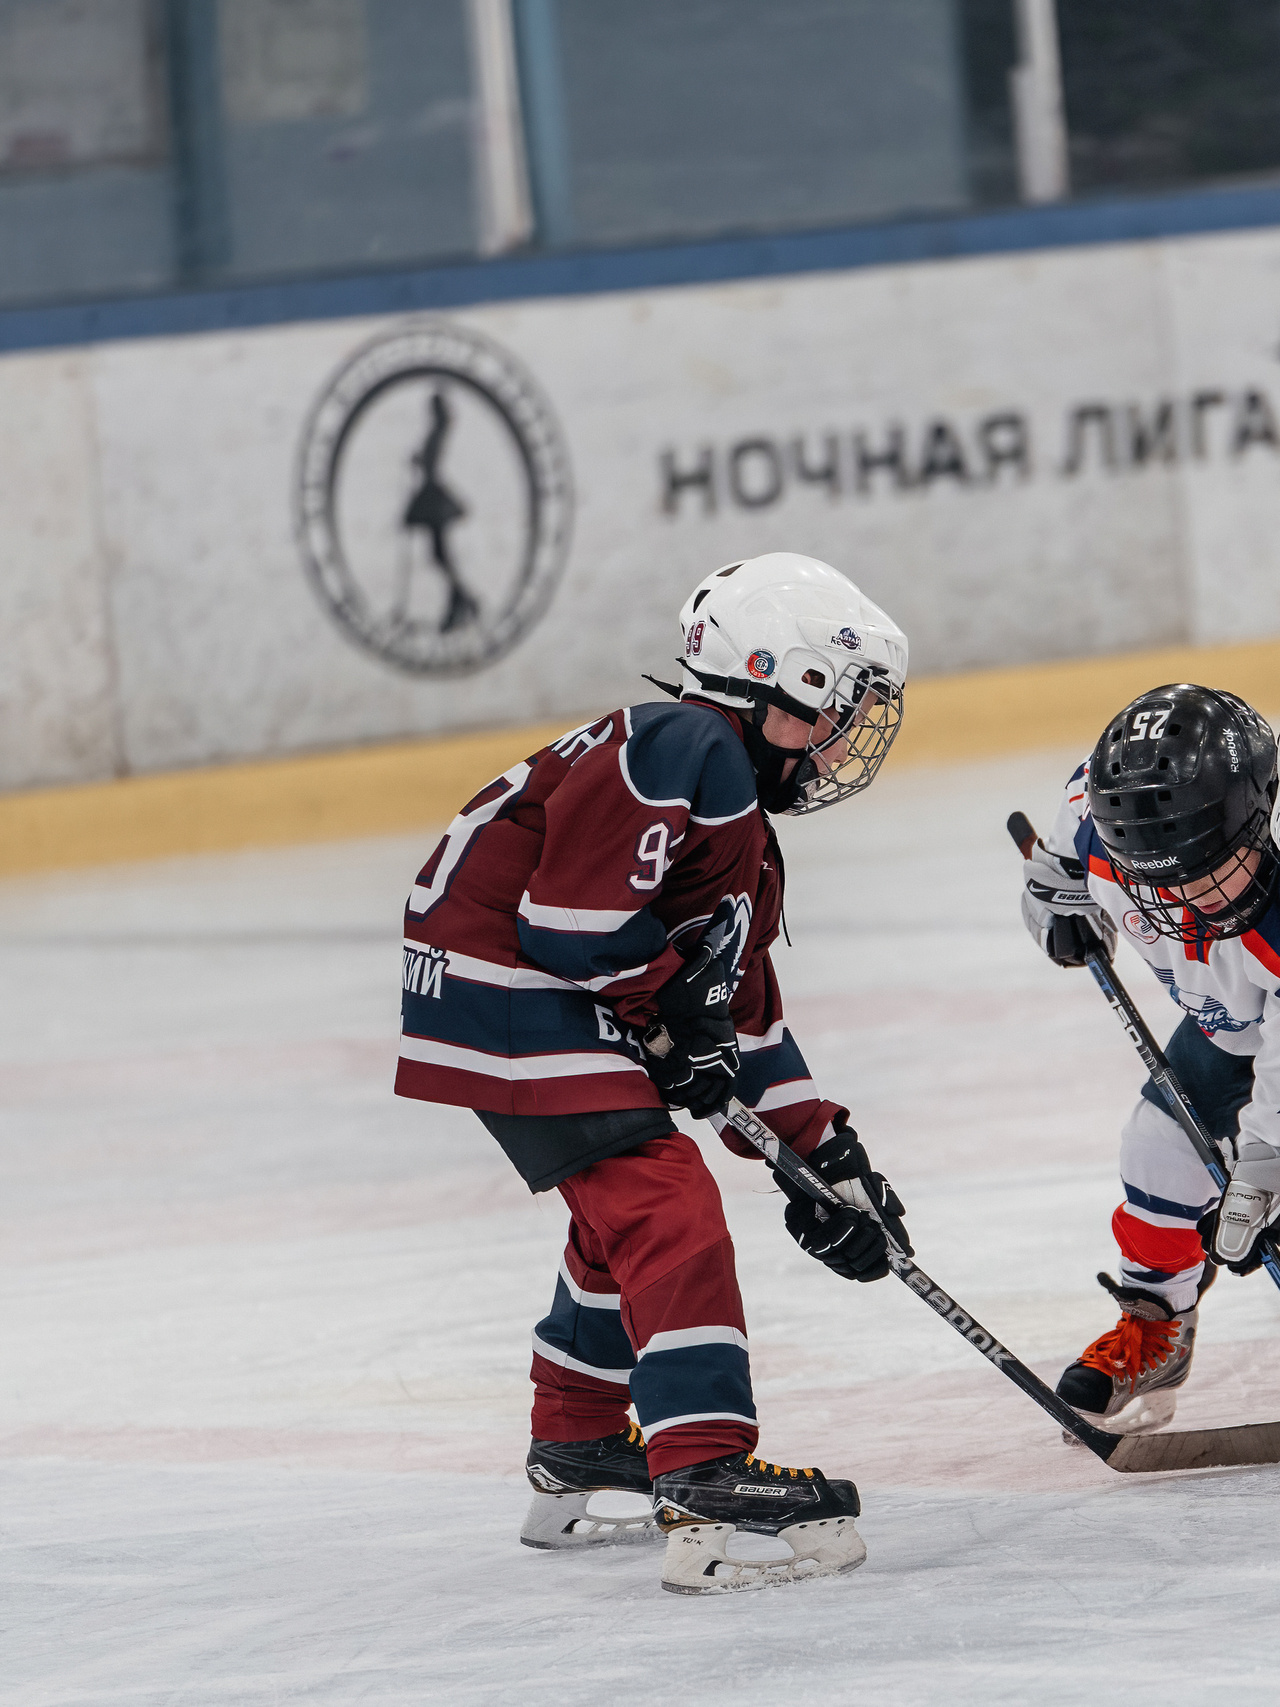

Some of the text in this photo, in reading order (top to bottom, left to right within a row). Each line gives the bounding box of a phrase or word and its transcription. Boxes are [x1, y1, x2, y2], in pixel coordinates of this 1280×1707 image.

[659, 410, 1034, 522] НОЧНАЯ
[1129, 709, 1171, 742] 25
[1222, 727, 1240, 773] Reebok
[628, 819, 686, 892] 9
[1130, 855, 1181, 870] Reebok
[1057, 893, 1094, 901] BAUE
[731, 1108, 778, 1152] 20K
[739, 1485, 782, 1495] BAUER
